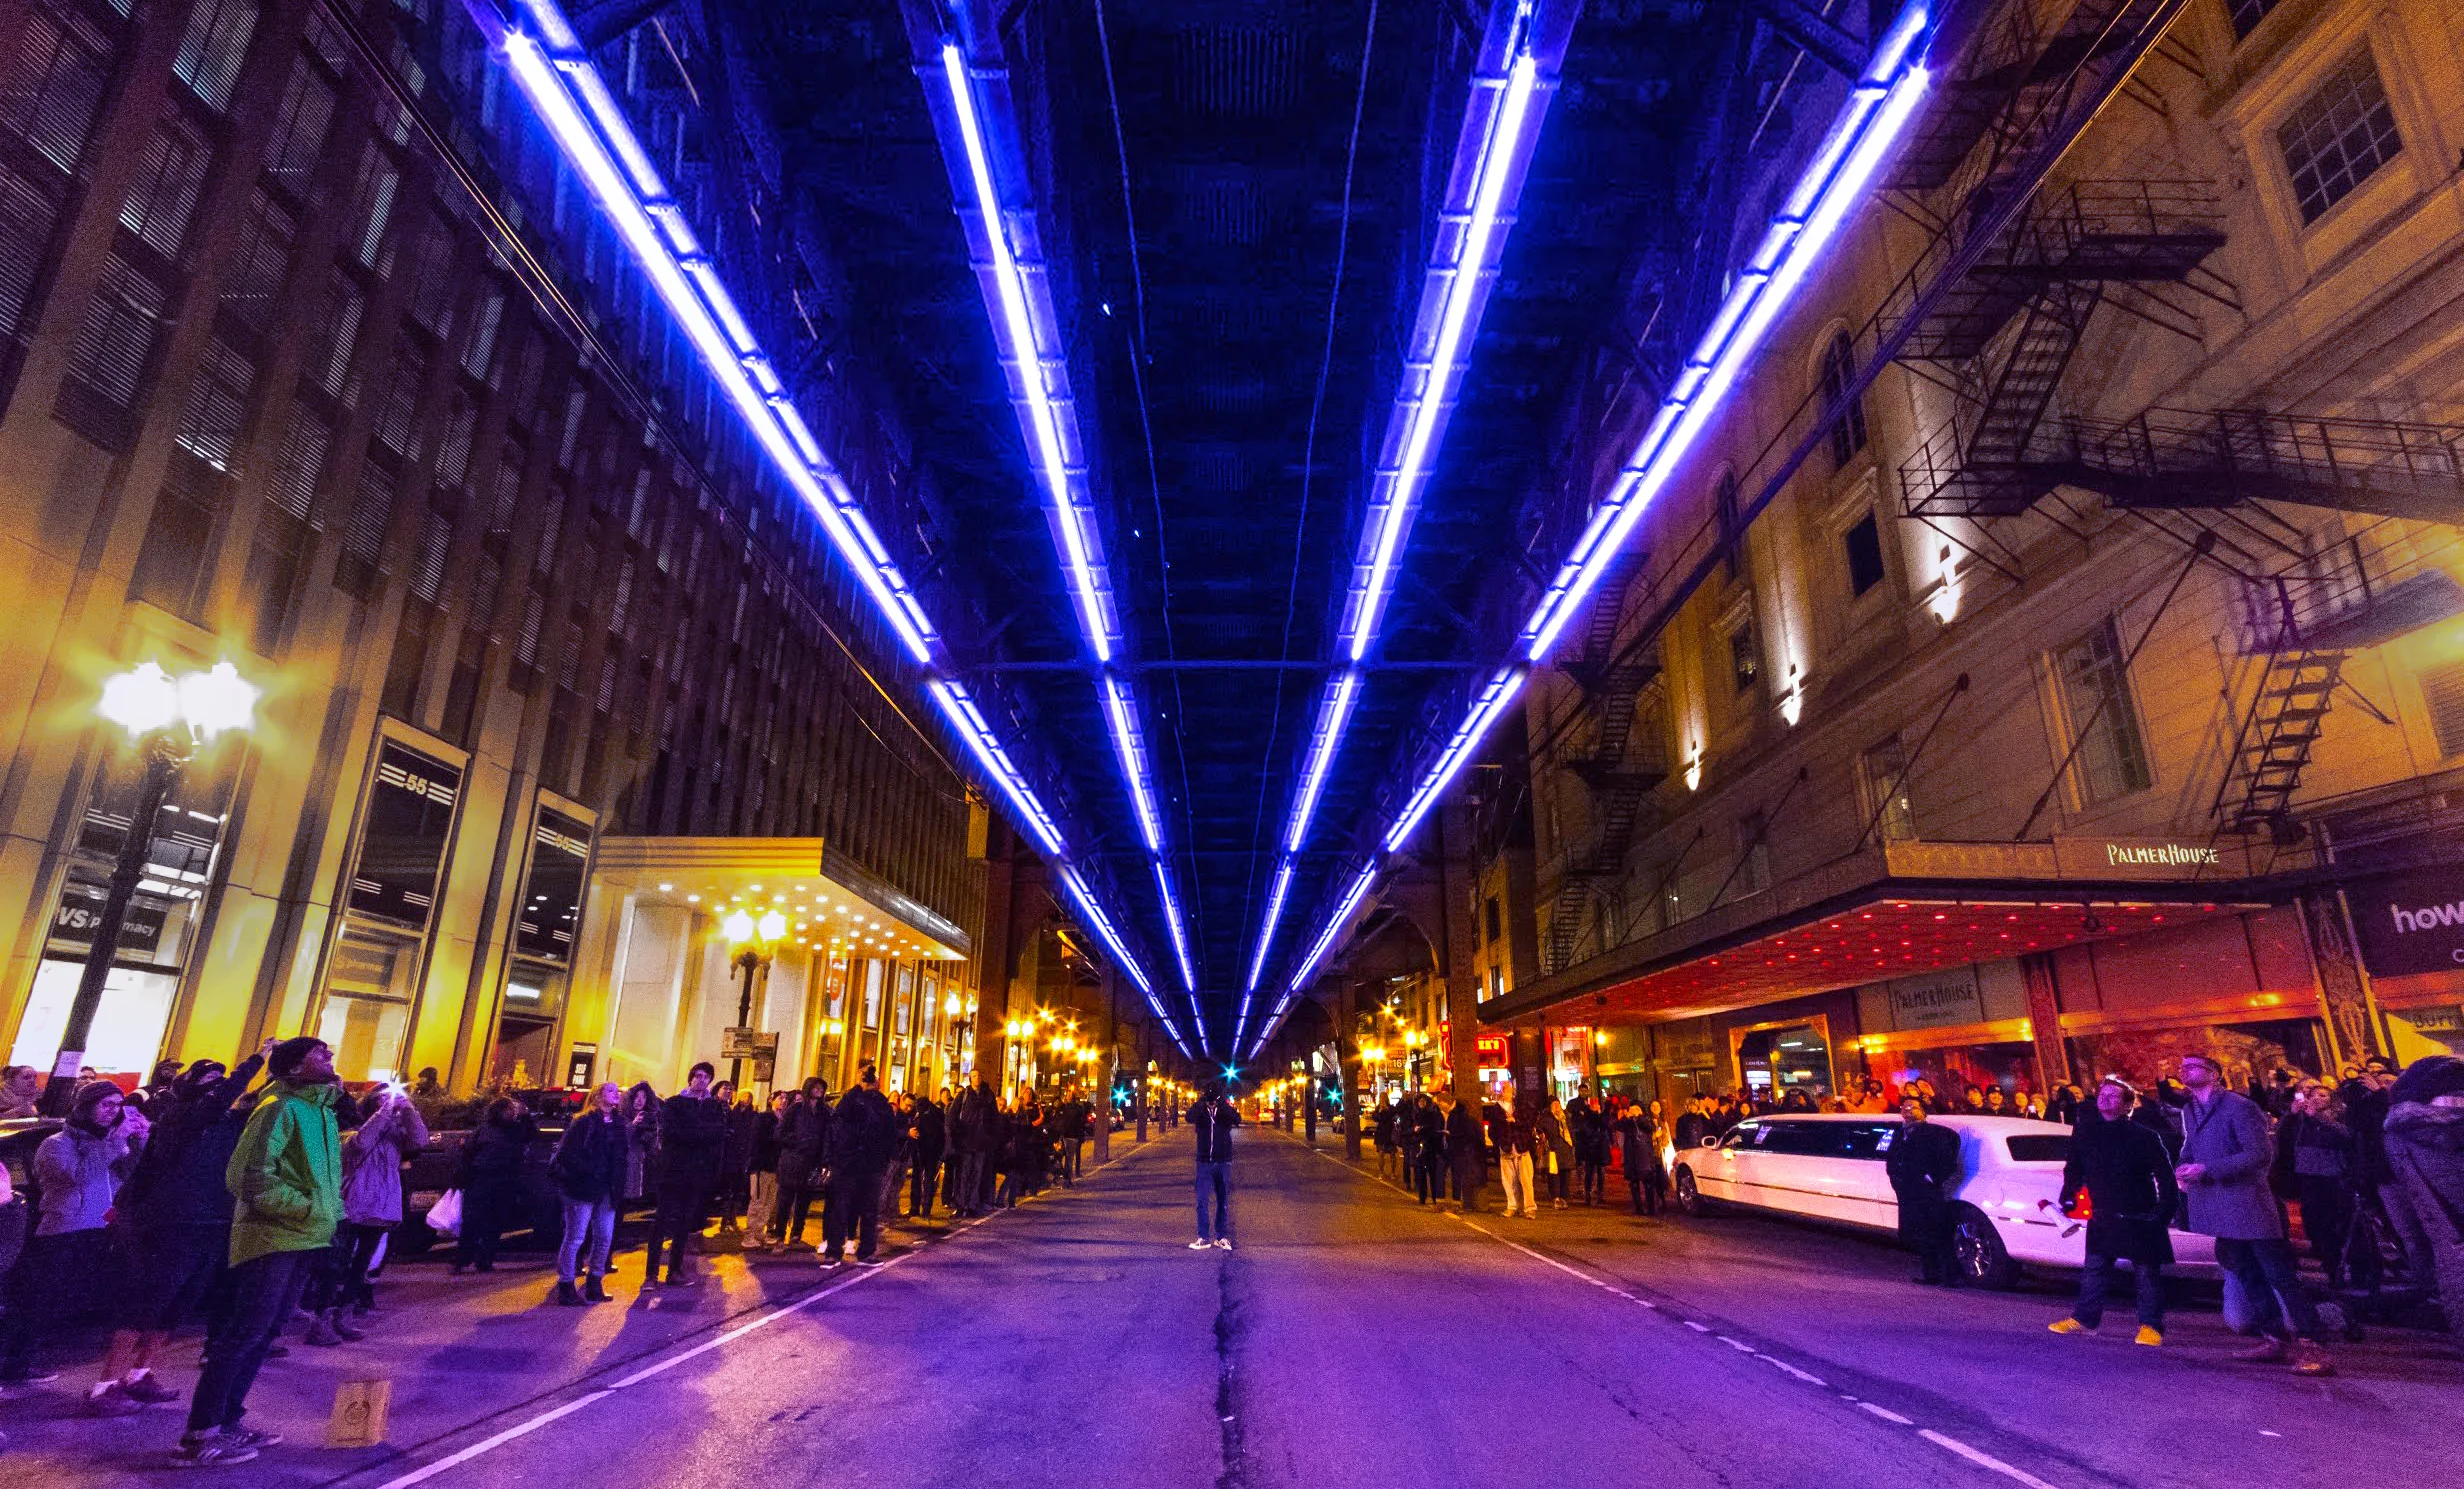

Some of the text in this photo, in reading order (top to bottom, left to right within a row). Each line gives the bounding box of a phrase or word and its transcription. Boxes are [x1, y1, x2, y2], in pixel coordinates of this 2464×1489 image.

[406, 774, 428, 795] 55
[58, 906, 156, 937] VS pmacy
